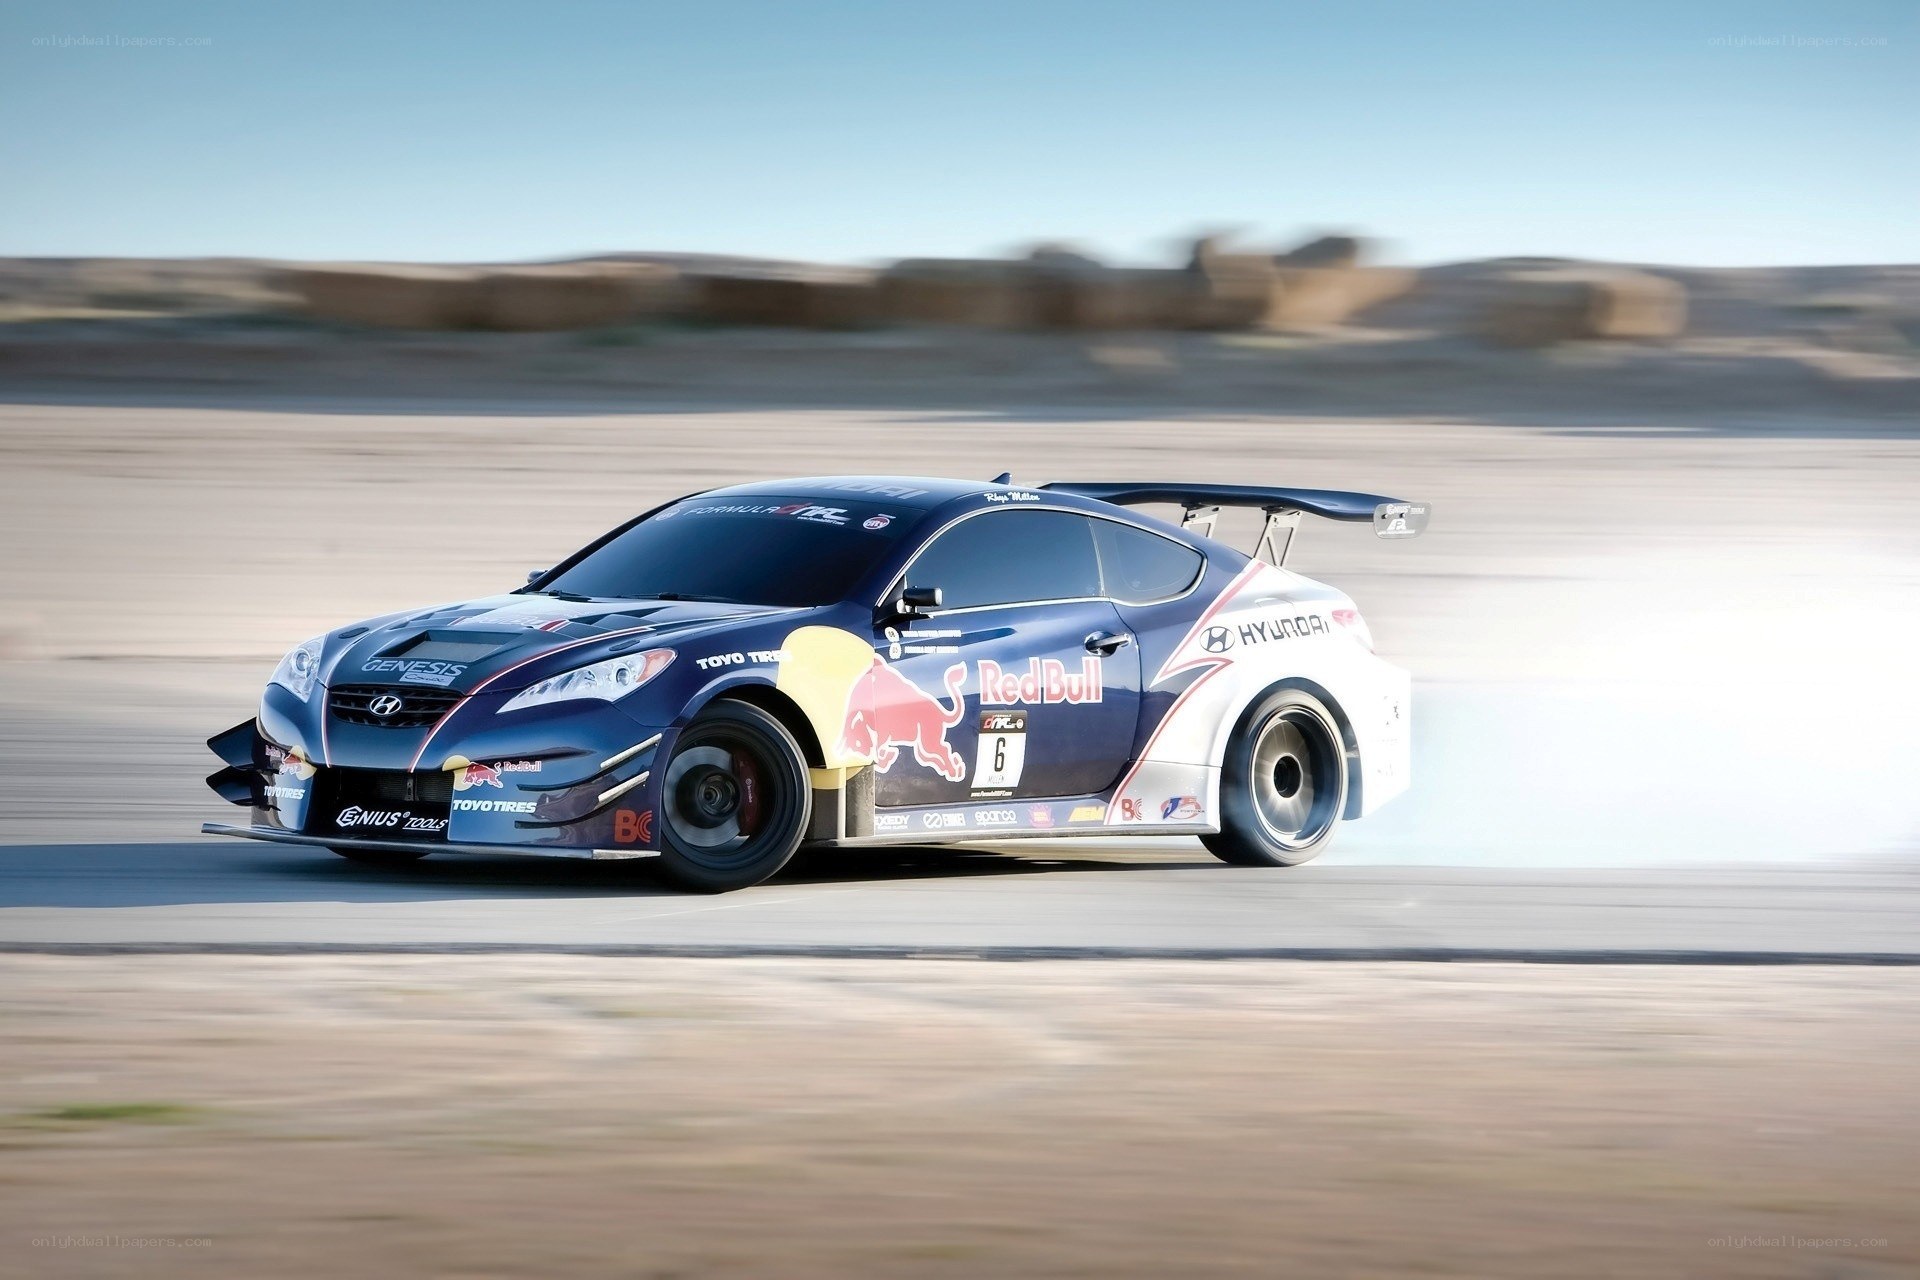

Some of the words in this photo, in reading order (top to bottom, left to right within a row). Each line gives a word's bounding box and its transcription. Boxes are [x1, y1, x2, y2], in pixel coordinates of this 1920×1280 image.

[684, 505, 779, 516] FORMULA
[1238, 614, 1331, 646] HYUNDAI
[361, 658, 468, 678] GENESIS
[696, 653, 745, 670] TOYO
[977, 657, 1041, 705] Red
[1042, 656, 1102, 704] Bull
[994, 737, 1006, 772] 6
[402, 816, 449, 832] TOOLS
